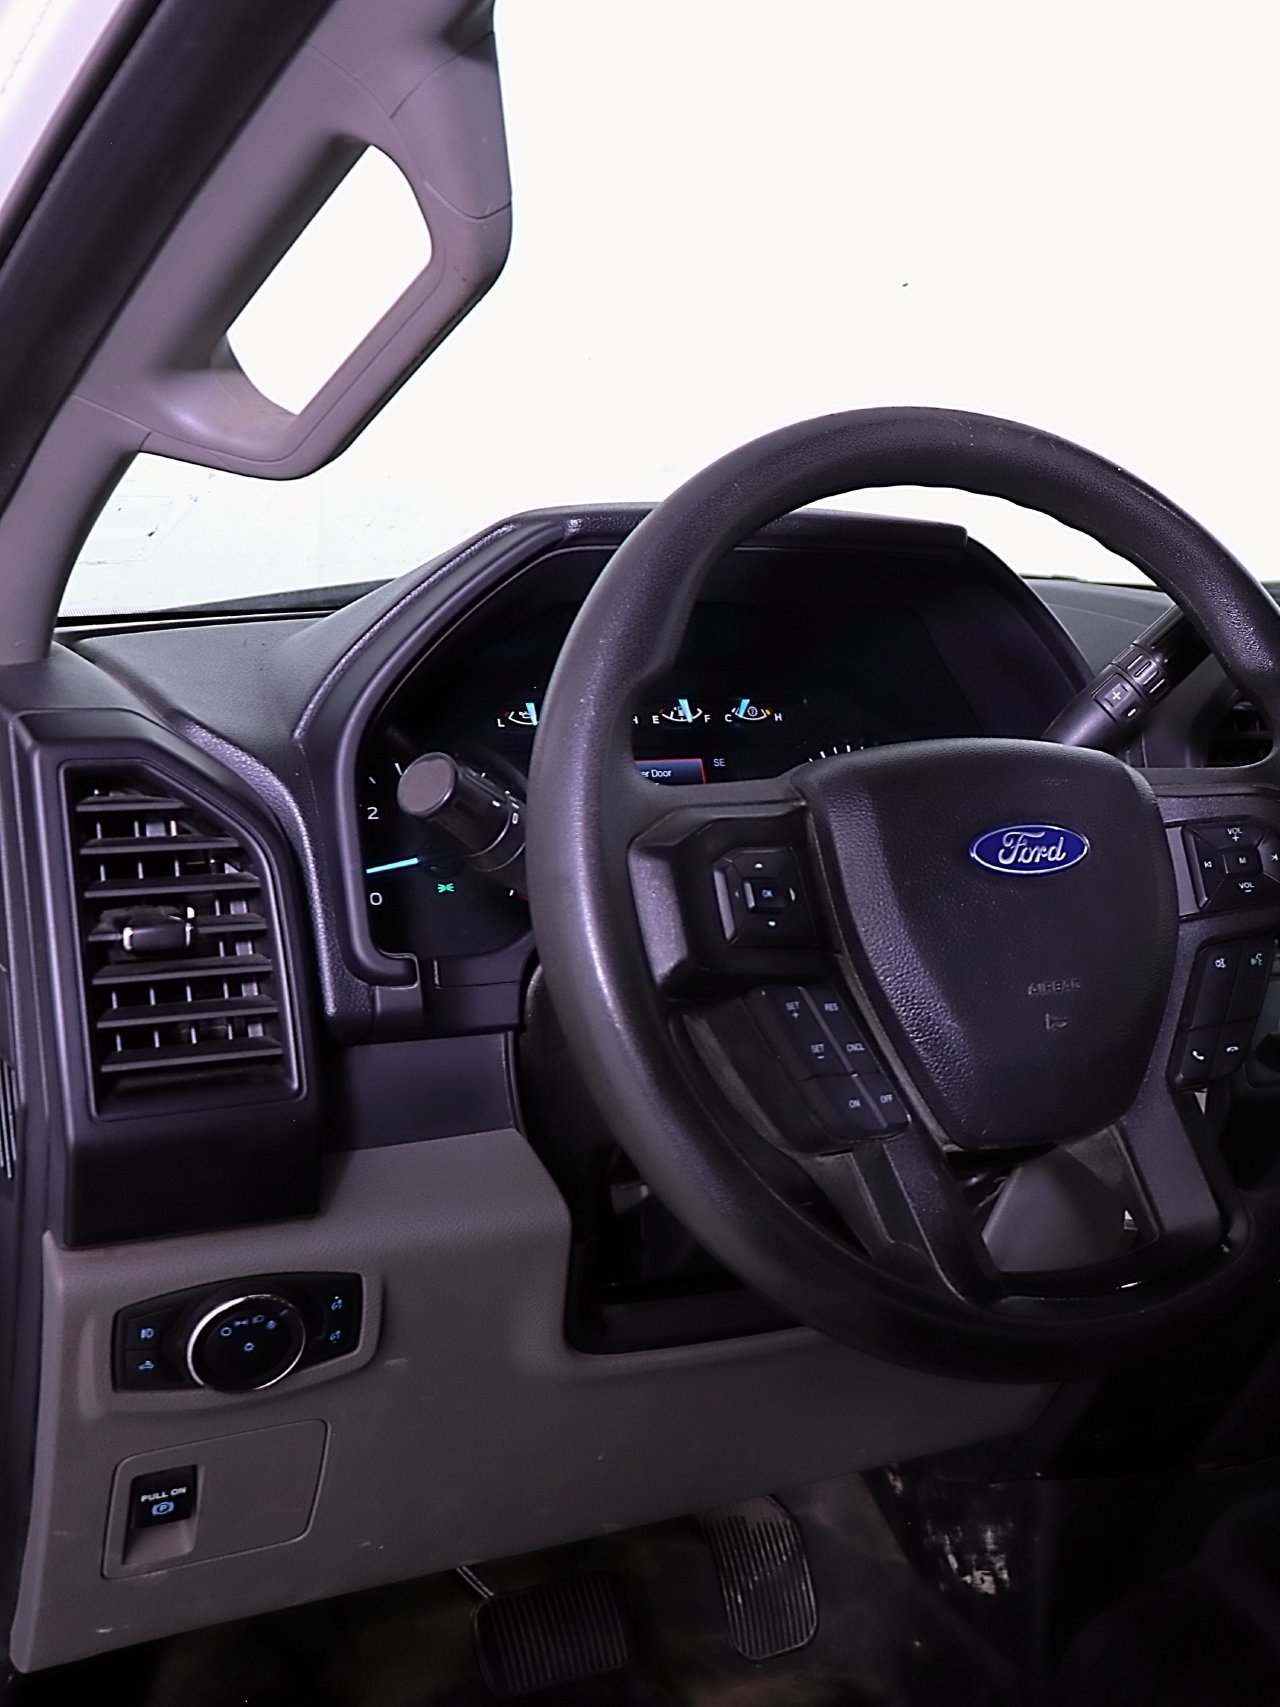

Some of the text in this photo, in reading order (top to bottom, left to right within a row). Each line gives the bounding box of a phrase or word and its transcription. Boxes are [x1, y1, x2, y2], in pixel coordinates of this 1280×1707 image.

[652, 715, 660, 724] E
[704, 714, 711, 723] F
[724, 714, 733, 722] C
[774, 713, 783, 721] H
[713, 758, 726, 767] SE
[651, 769, 672, 777] Door
[367, 806, 379, 819] 2
[1227, 827, 1243, 835] VOL
[997, 830, 1067, 865] Ford
[1238, 881, 1255, 889] VOL
[369, 892, 383, 905] 0
[824, 1003, 839, 1011] RES
[811, 1043, 824, 1053] SET
[880, 1094, 893, 1103] OFF
[848, 1099, 861, 1108] ON
[141, 1486, 187, 1502] PULL ON
